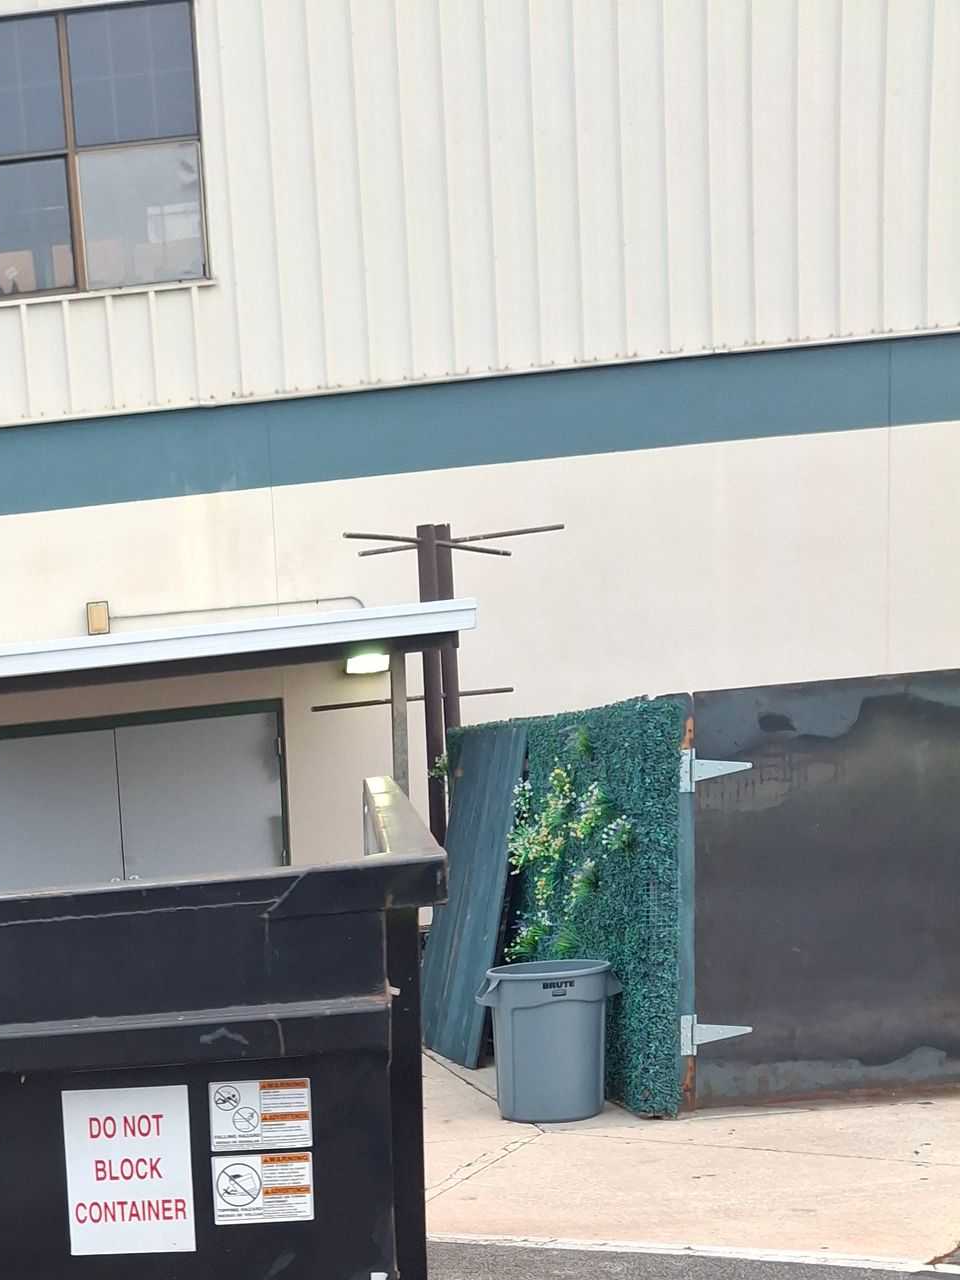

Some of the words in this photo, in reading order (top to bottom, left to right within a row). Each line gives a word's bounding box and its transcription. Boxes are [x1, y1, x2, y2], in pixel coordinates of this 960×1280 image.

[542, 980, 575, 990] BRUTE
[89, 1116, 117, 1138] DO
[123, 1114, 163, 1137] NOT
[94, 1157, 163, 1181] BLOCK
[269, 1154, 309, 1162] WARNING
[75, 1199, 187, 1224] CONTAINER
